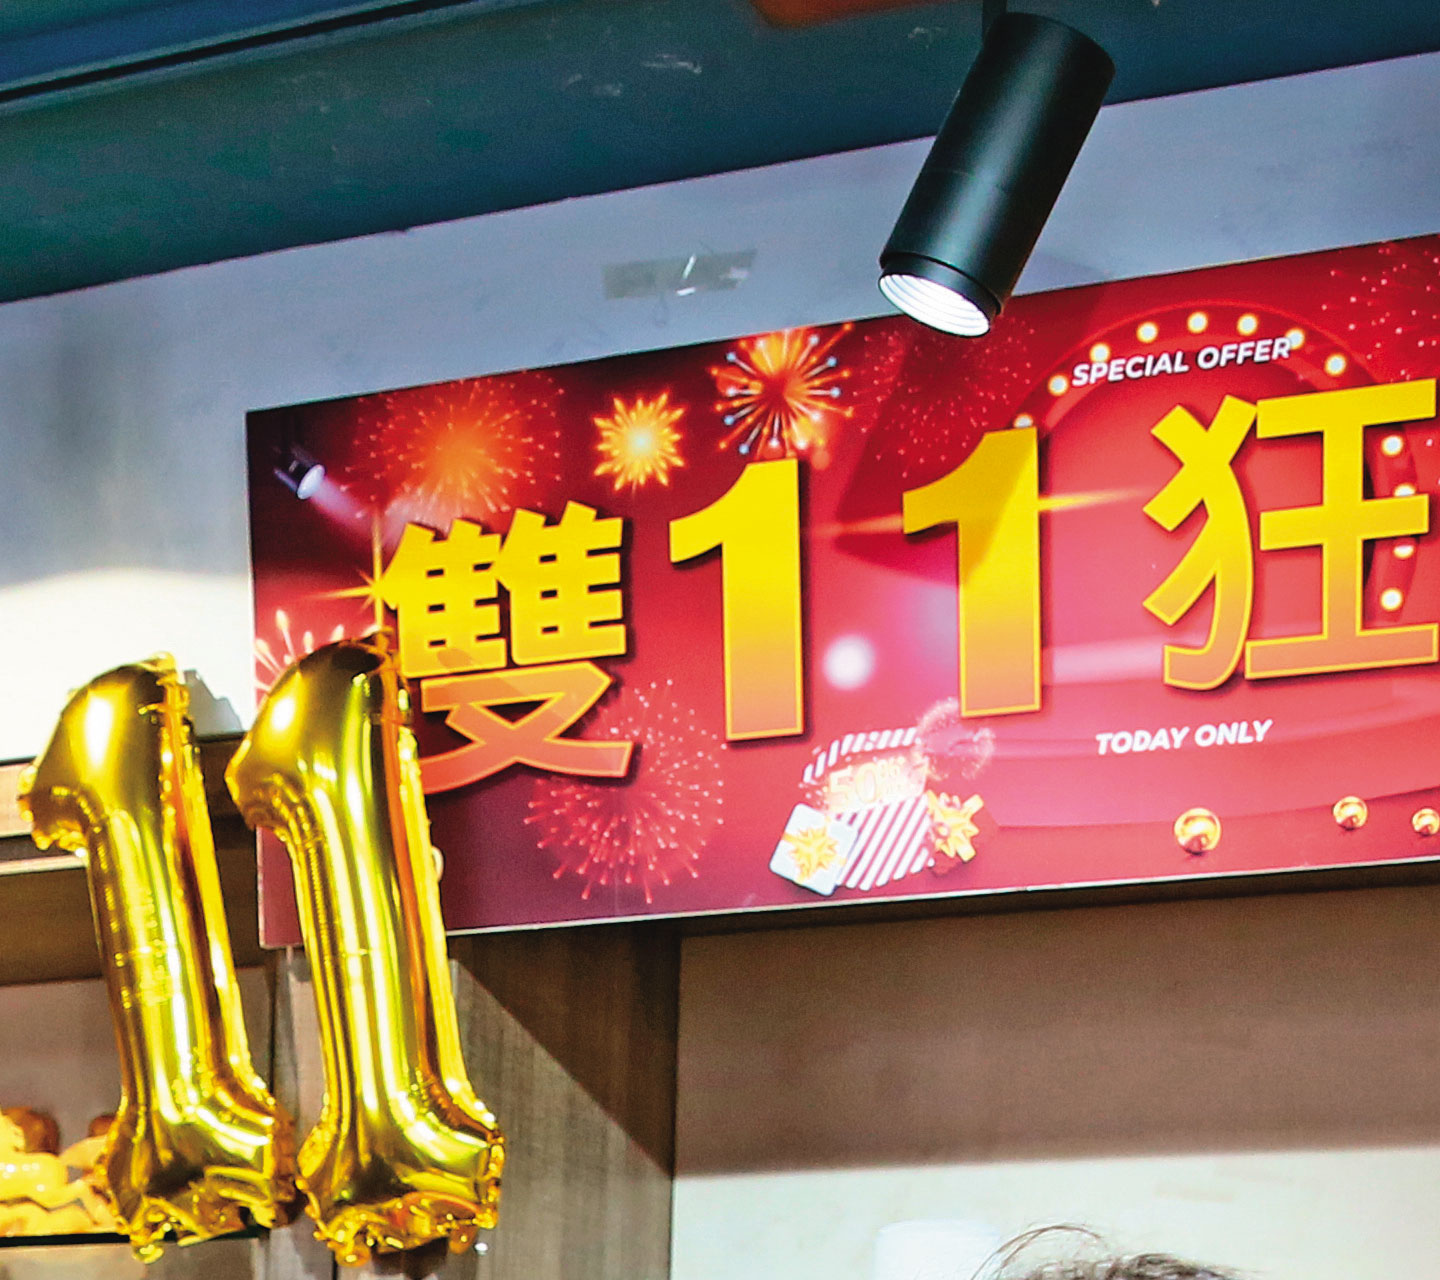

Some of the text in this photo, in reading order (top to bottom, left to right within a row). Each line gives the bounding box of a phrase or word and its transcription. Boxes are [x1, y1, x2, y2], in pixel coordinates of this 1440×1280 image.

[1072, 336, 1292, 387] SPECIAL OFFER
[1096, 719, 1272, 756] TODAY ONLY
